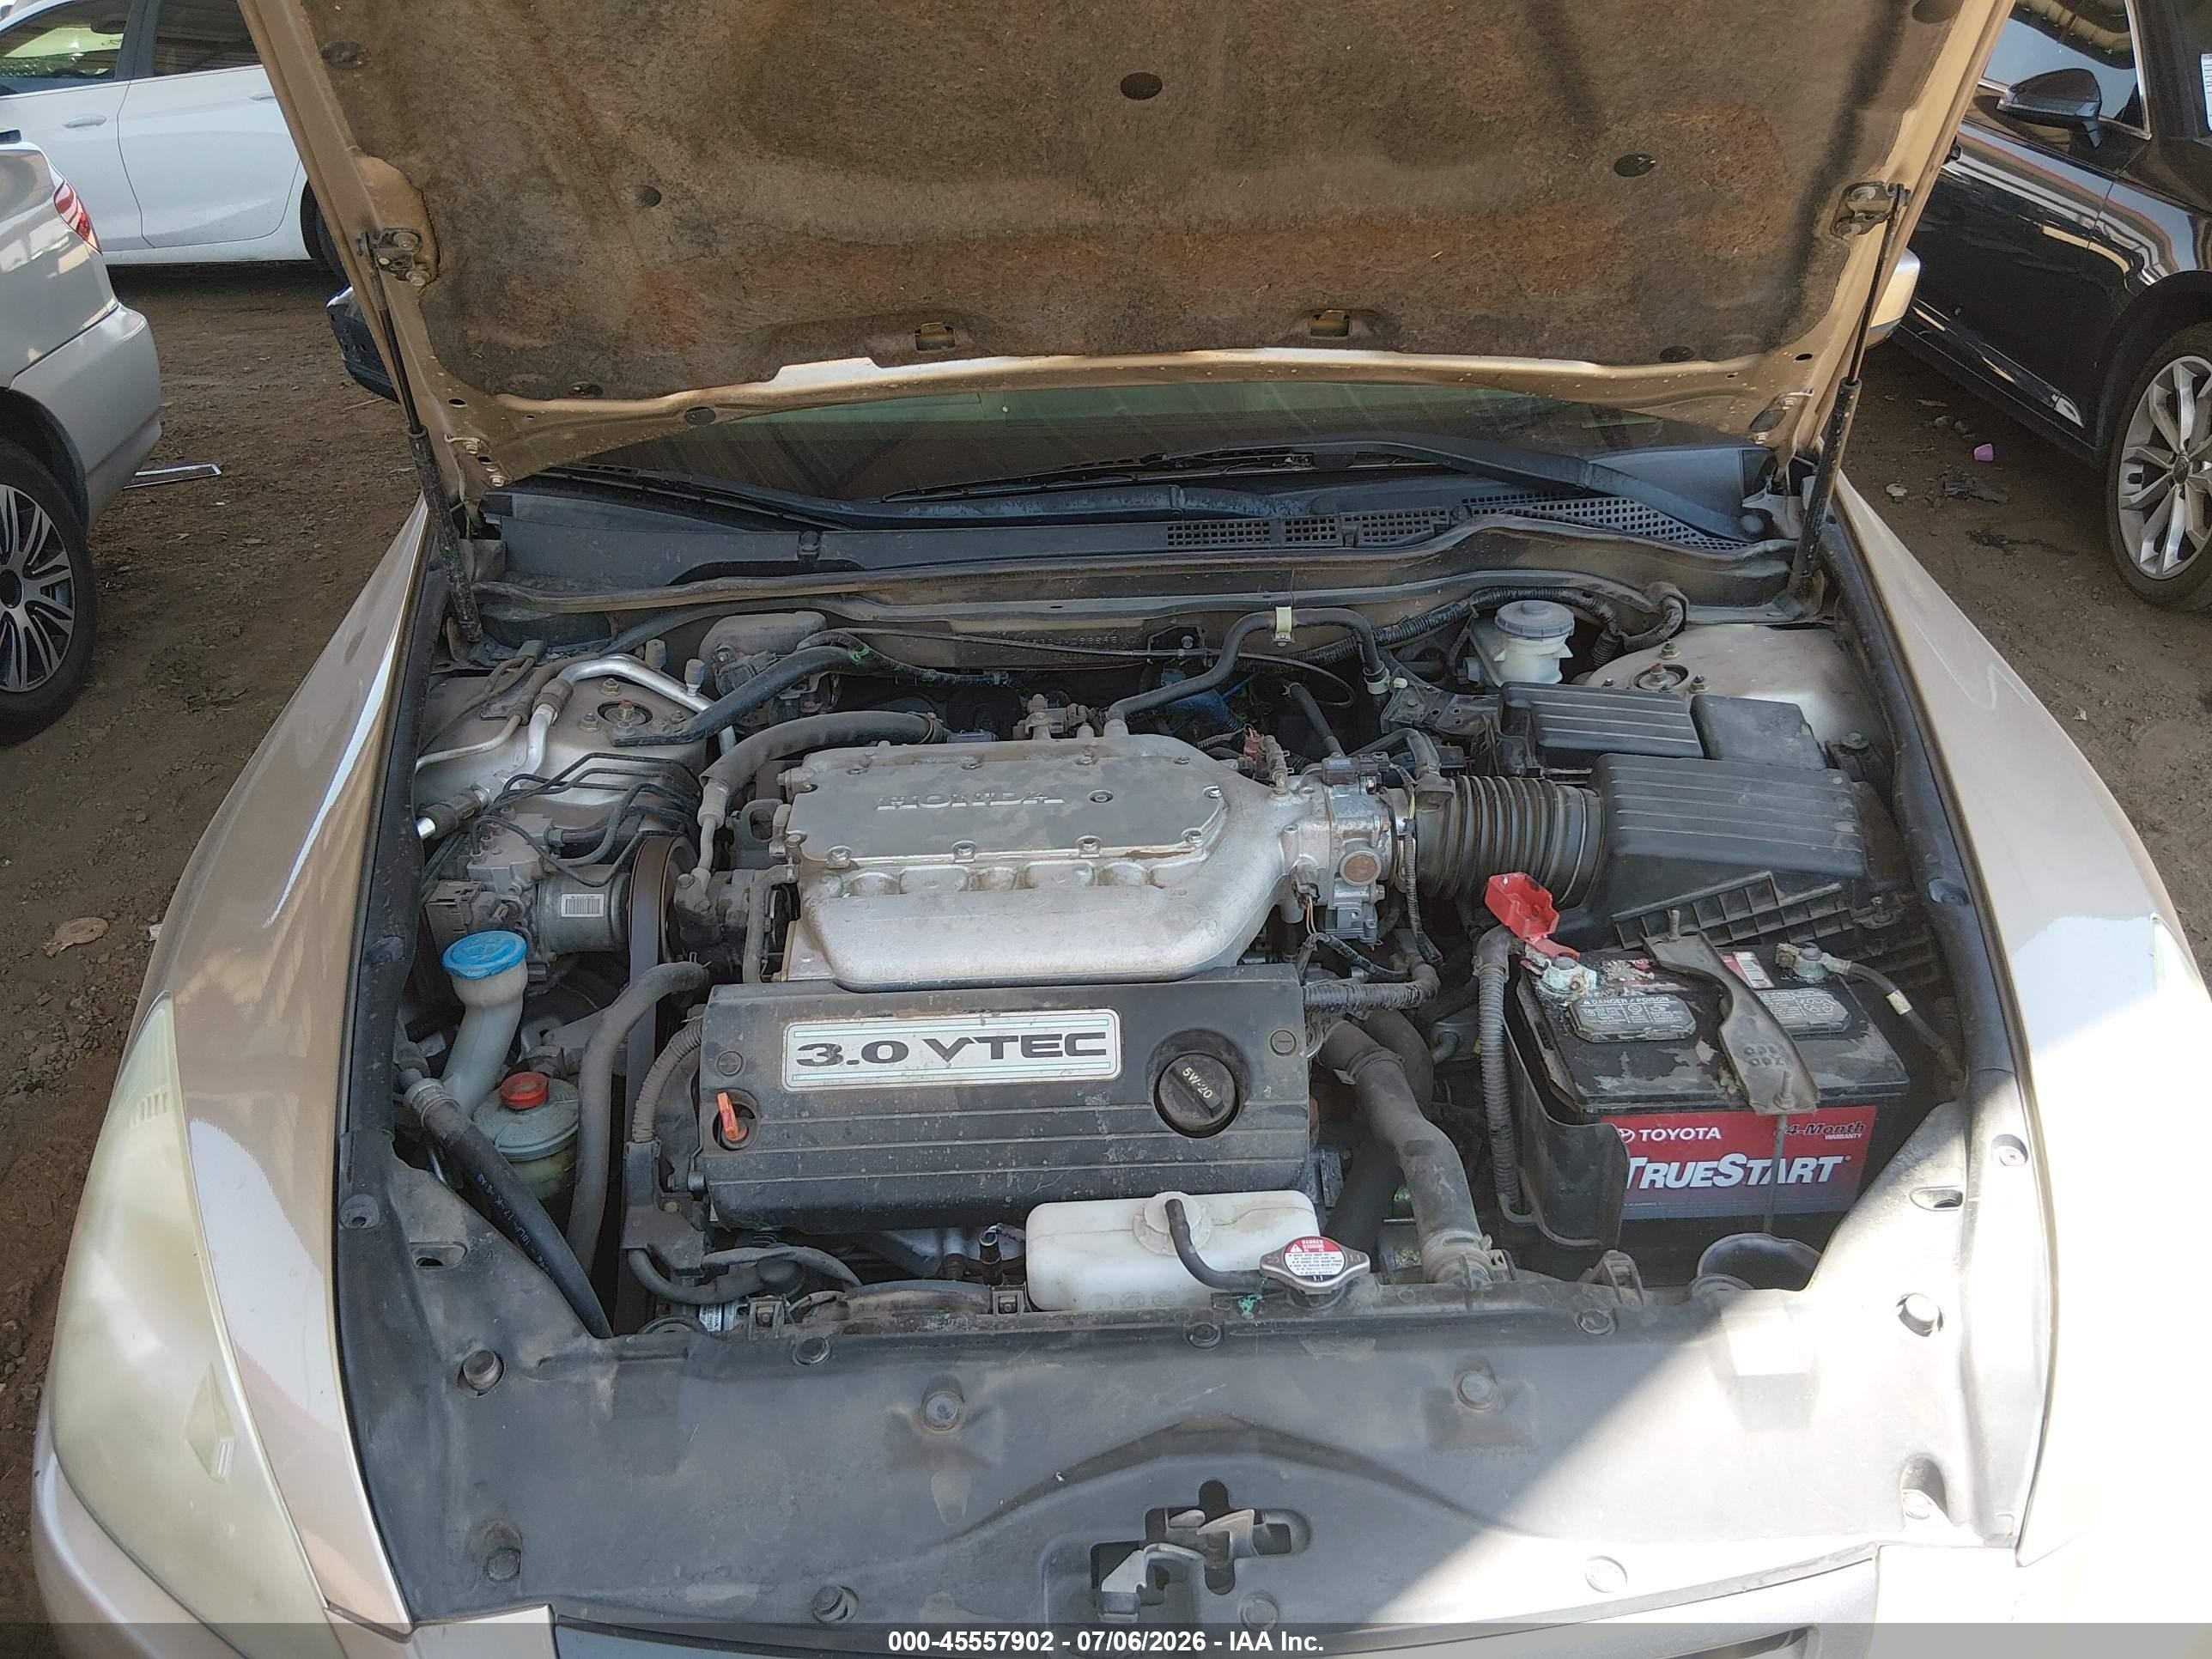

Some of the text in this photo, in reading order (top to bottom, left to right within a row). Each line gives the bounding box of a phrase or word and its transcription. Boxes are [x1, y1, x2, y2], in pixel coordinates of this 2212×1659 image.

[878, 791, 1064, 810] HONDA
[796, 1031, 1107, 1066] 3.0 VTEC
[1182, 1066, 1213, 1099] 5W-20
[1638, 1127, 1722, 1142] TOYOTA
[1774, 1121, 1866, 1135] 4-Month
